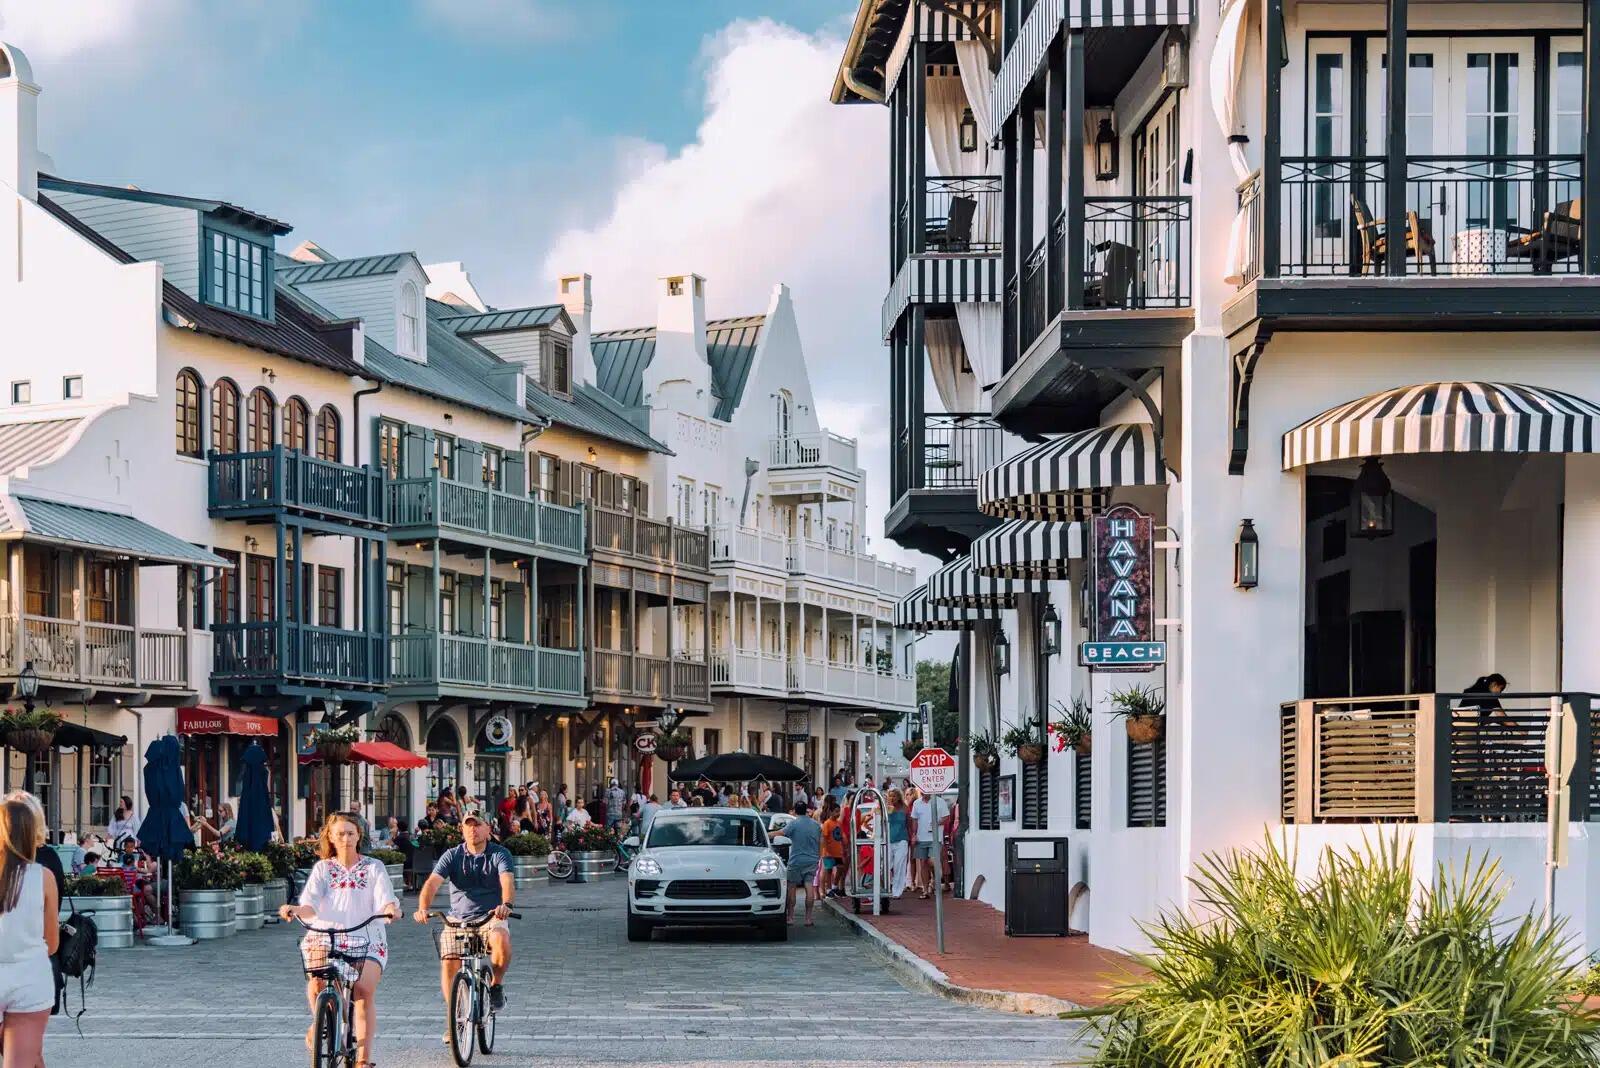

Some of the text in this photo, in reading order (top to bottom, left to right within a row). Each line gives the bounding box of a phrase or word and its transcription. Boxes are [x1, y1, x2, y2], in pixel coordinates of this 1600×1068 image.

[1110, 520, 1136, 636] HAVANA
[1088, 647, 1162, 658] BEACH
[183, 720, 261, 730] FABULOUS TOYS
[919, 754, 946, 766] STOP
[922, 775, 945, 783] ENTER
